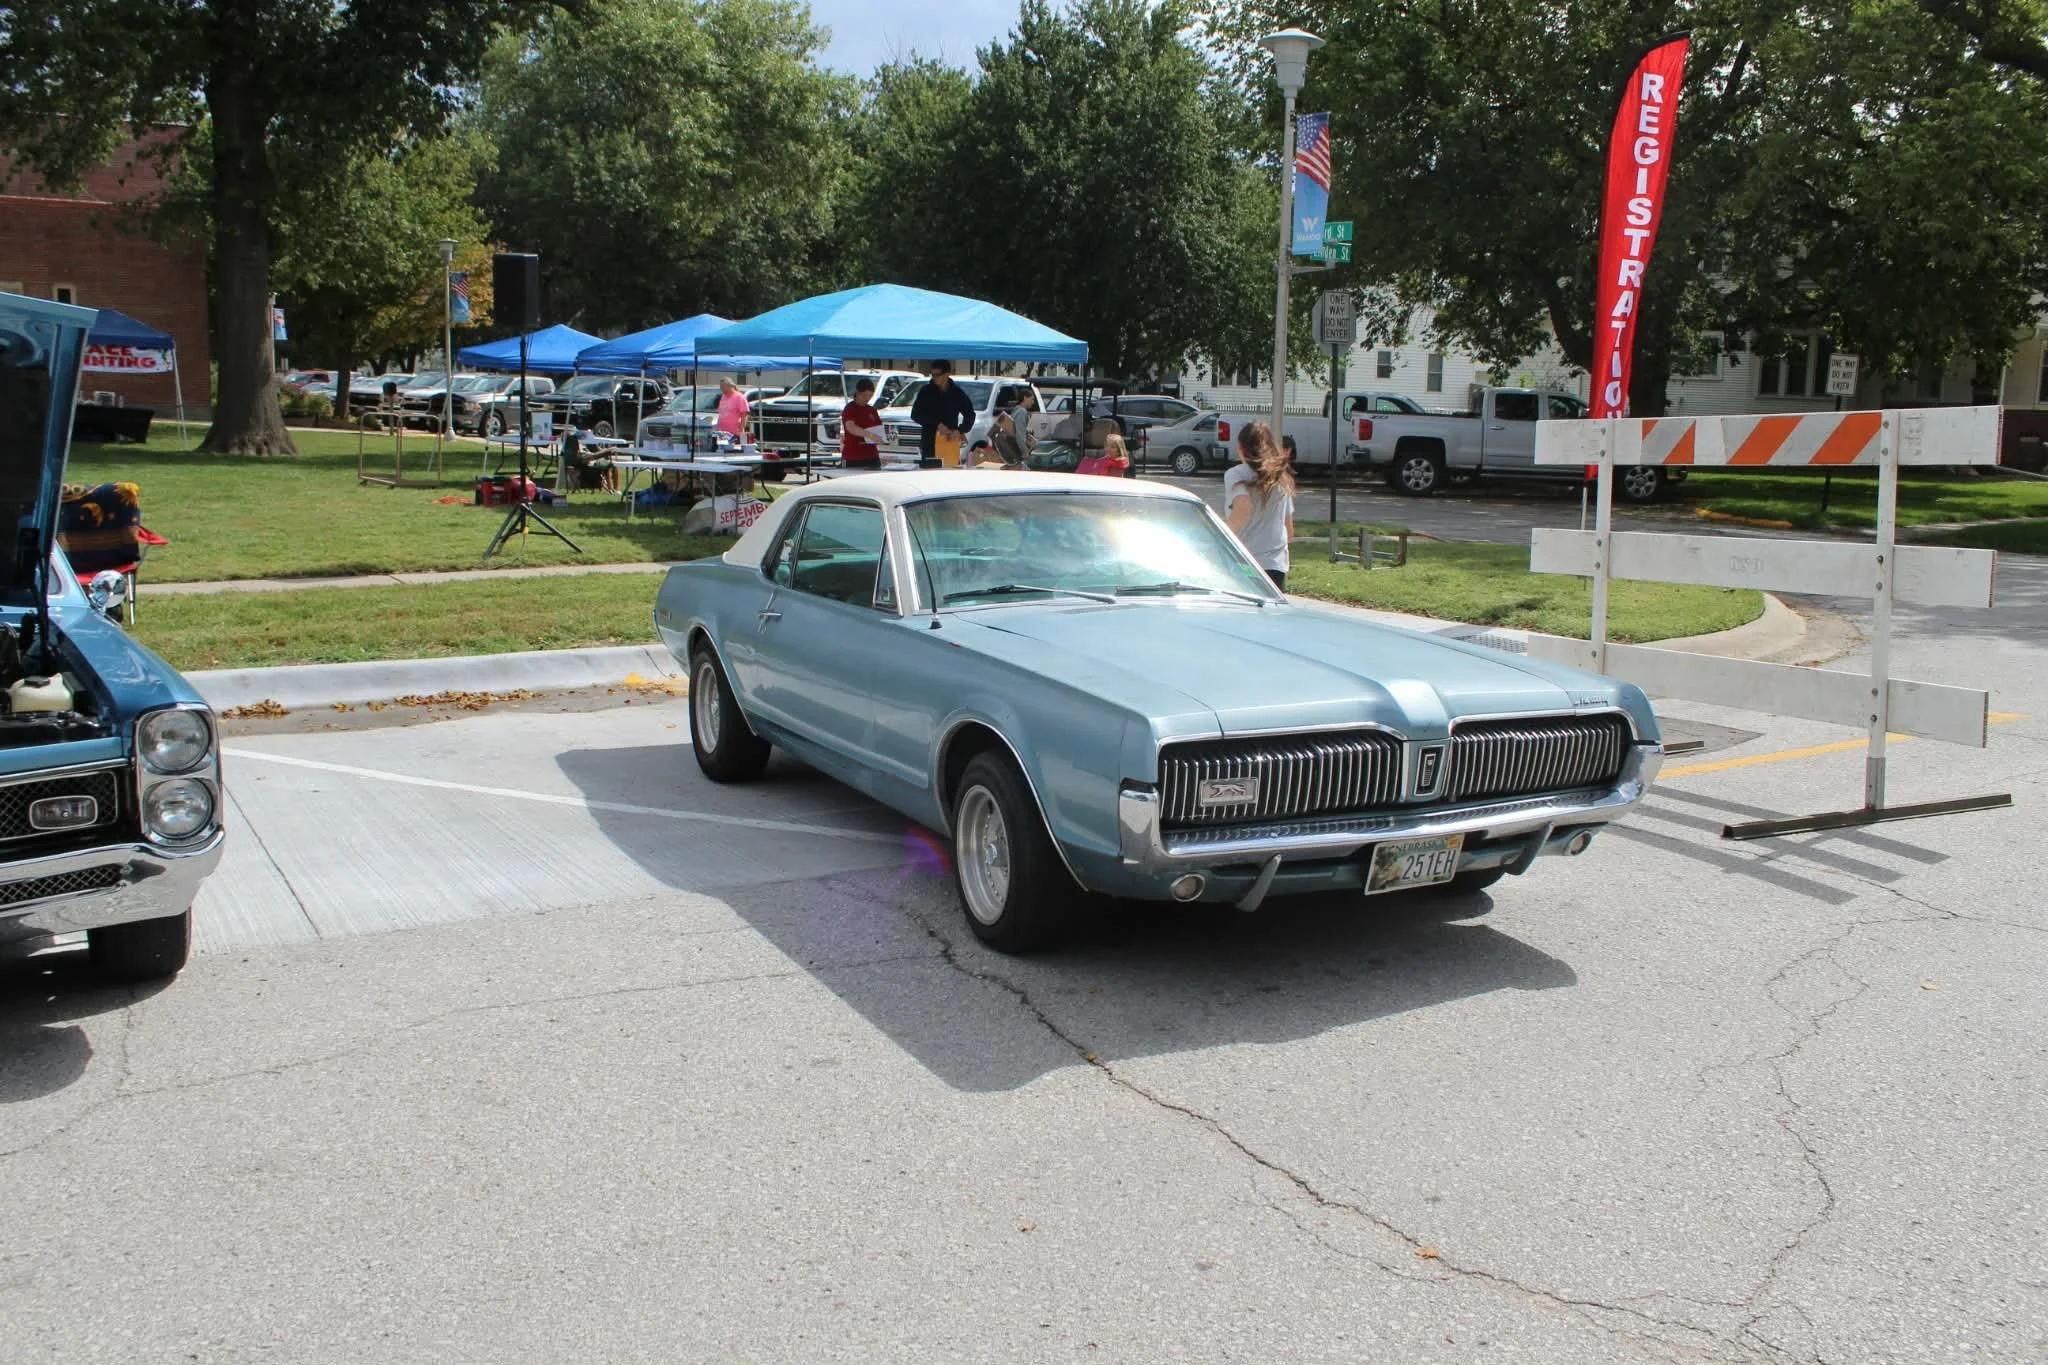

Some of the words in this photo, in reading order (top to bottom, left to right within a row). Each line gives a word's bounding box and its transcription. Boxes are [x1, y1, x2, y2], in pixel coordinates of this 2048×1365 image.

[1337, 224, 1345, 239] St
[1341, 246, 1349, 260] St
[1330, 295, 1345, 304] ONE
[1329, 307, 1345, 315] WAY
[1326, 318, 1336, 327] DO
[1337, 318, 1350, 327] NOT
[1326, 329, 1348, 338] ENTER
[1831, 359, 1842, 368] ONE
[1845, 360, 1856, 368] WAY
[1832, 370, 1840, 378] DO
[1842, 371, 1854, 379] NOT
[1832, 381, 1850, 391] ENTER
[720, 503, 768, 524] SEPTEMB
[737, 516, 759, 528] 20
[1401, 849, 1456, 880] 251EH
